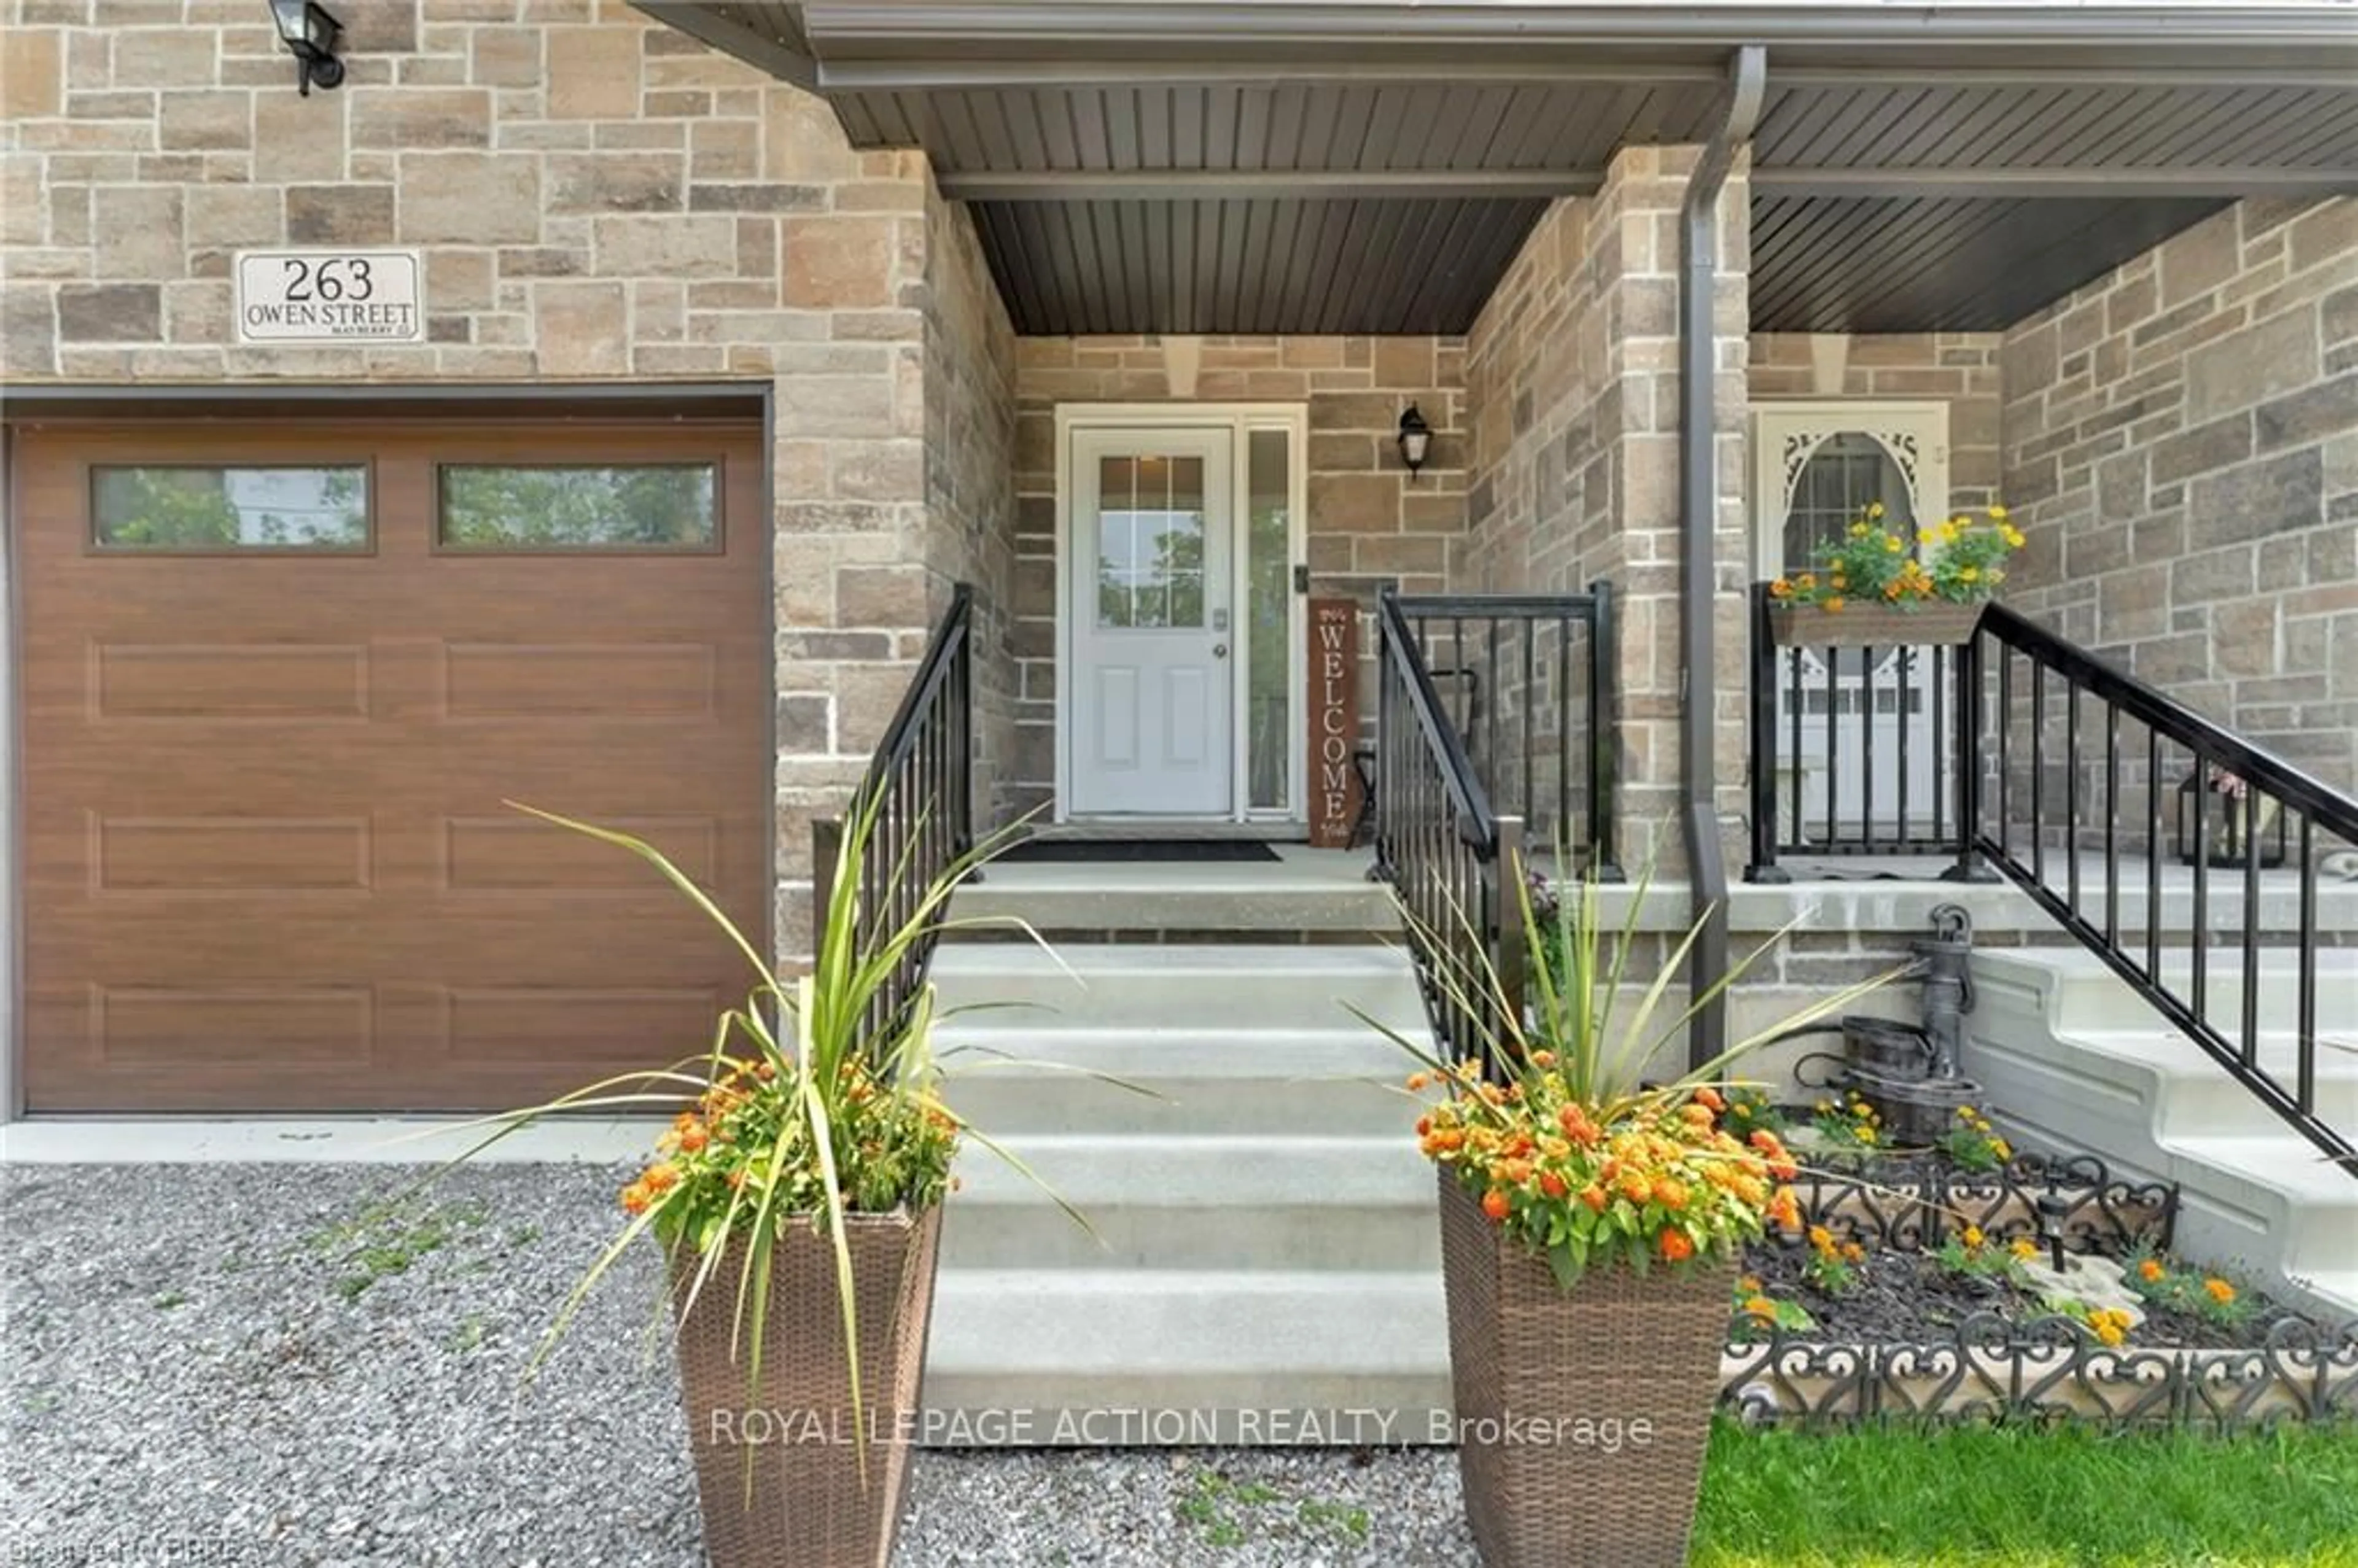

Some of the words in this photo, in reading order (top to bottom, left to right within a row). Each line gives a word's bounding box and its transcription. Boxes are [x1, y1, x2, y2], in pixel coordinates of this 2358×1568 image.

[284, 259, 373, 301] 263
[247, 305, 316, 325] OWEN
[321, 303, 412, 325] STREET
[1319, 625, 1346, 820] WELCOME
